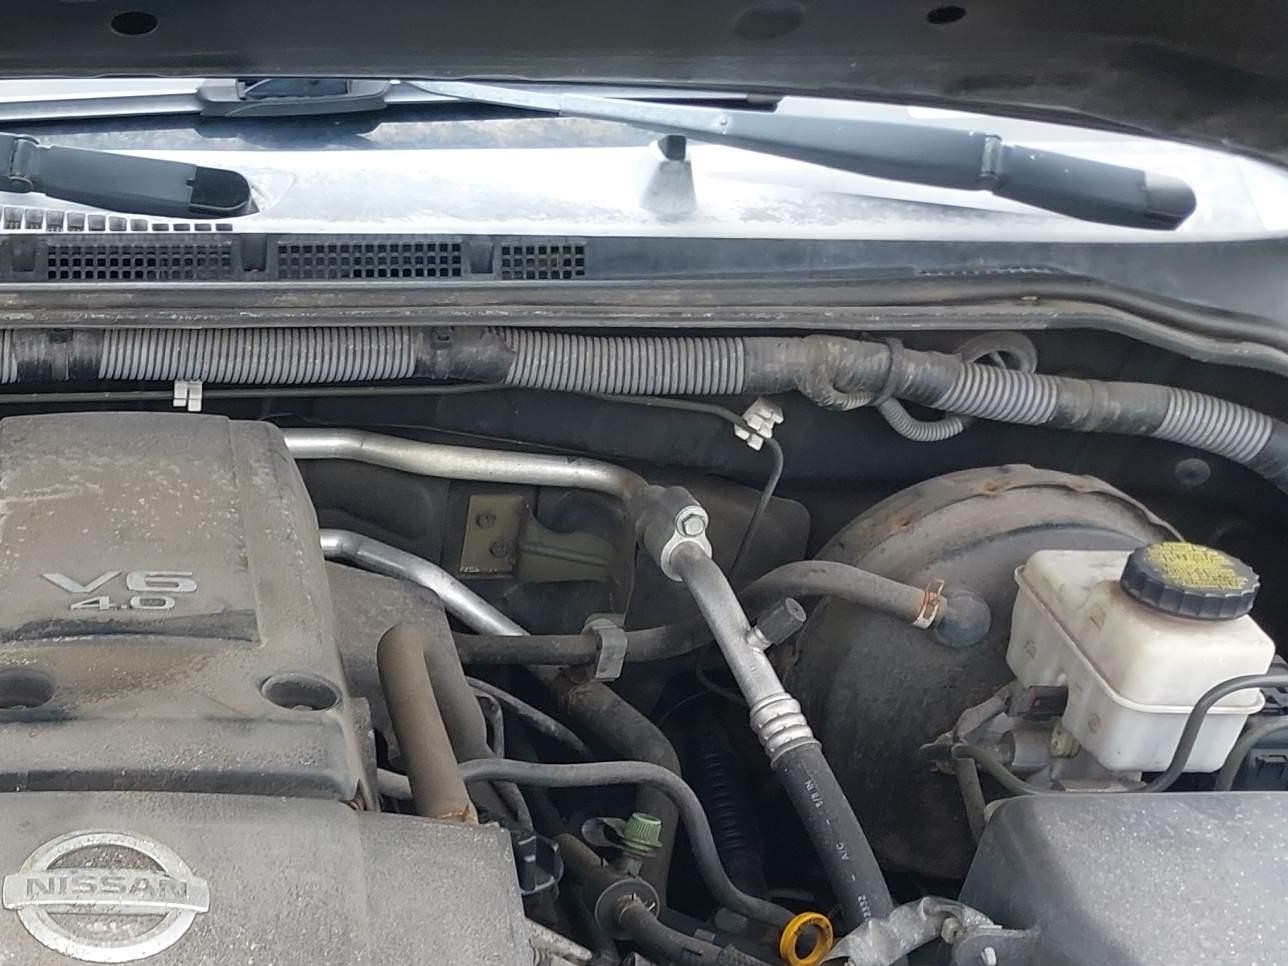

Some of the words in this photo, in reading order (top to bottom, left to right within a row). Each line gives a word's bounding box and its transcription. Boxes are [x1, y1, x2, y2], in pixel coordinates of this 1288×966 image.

[40, 570, 197, 593] V6
[70, 595, 176, 610] 4.0
[25, 875, 188, 899] NISSAN
